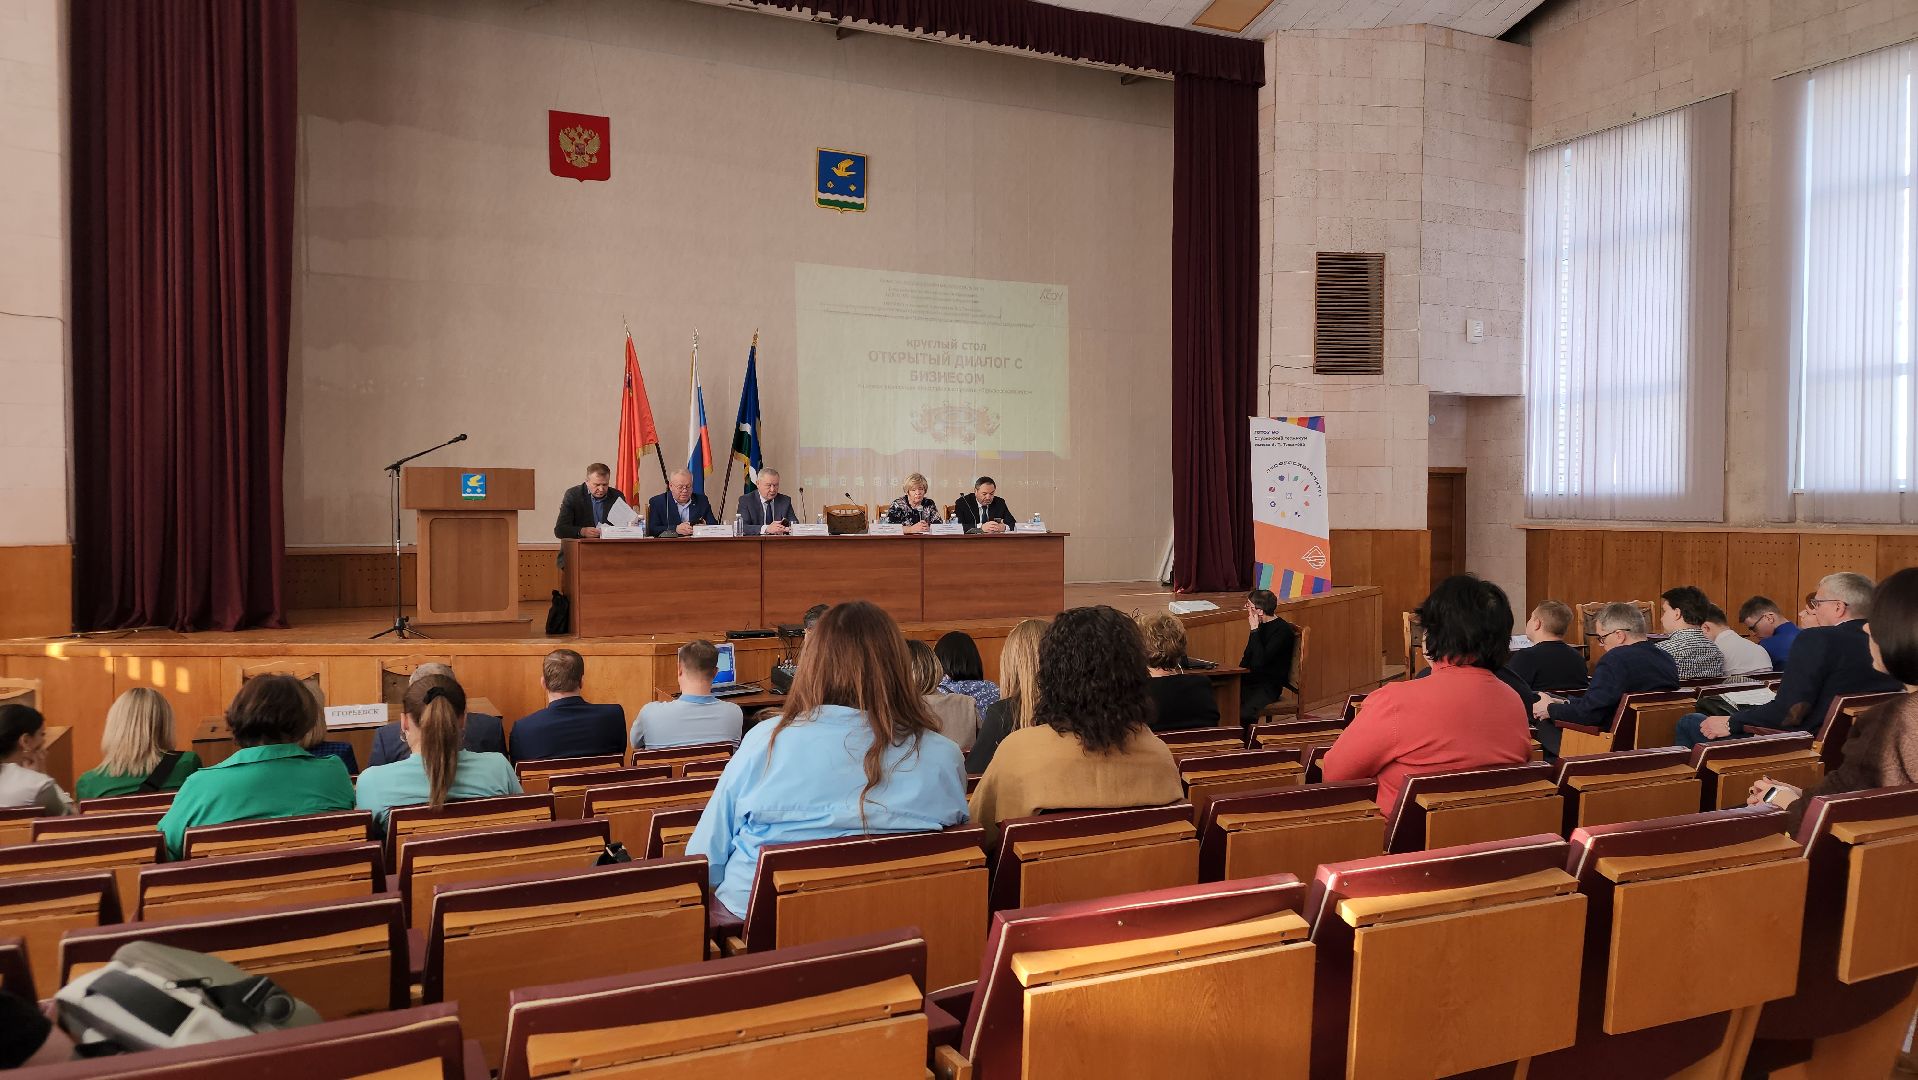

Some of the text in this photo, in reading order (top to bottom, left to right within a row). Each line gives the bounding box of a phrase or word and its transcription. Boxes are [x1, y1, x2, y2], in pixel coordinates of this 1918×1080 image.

[906, 338, 987, 351] круглый стол
[868, 350, 1023, 370] ОТКРЫТЫЙ ДИАЛОГ С
[910, 370, 985, 384] БИЗНЕСОМ
